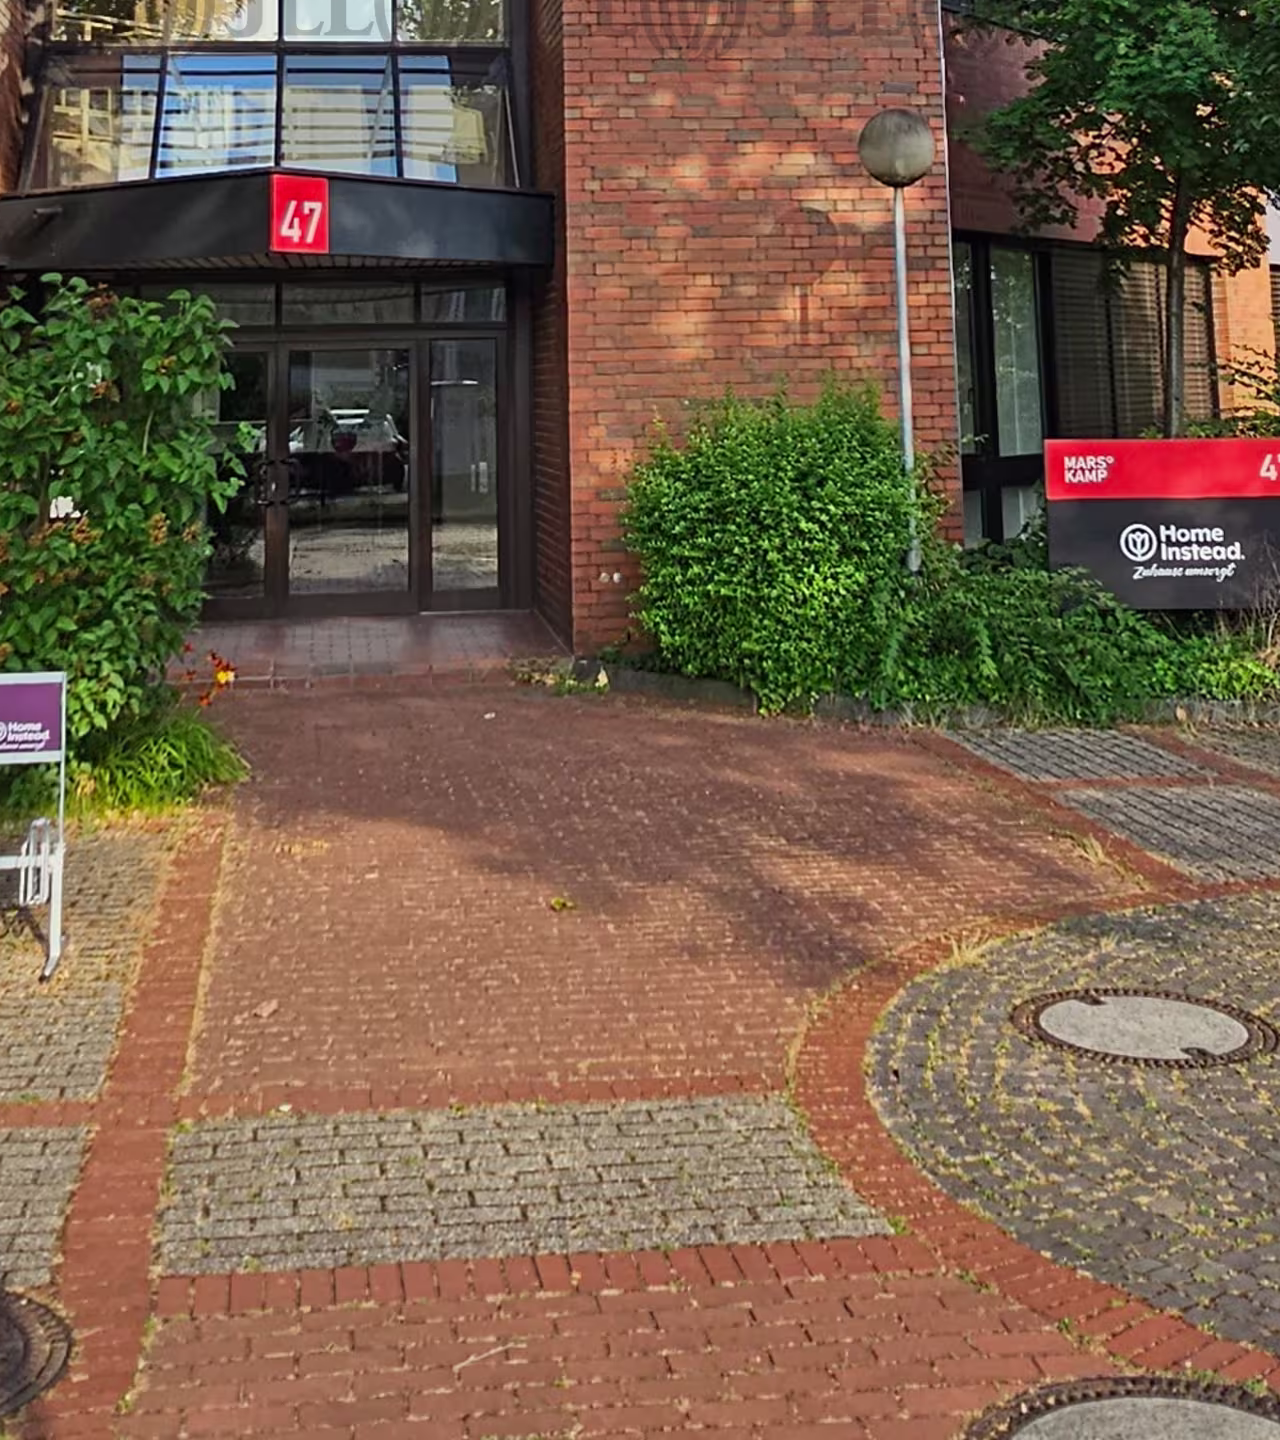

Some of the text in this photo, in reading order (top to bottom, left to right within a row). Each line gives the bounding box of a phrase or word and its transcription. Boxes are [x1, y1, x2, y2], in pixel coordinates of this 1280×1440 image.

[279, 200, 323, 244] 47
[1064, 469, 1108, 483] KAMP
[1160, 524, 1224, 542] Home
[1161, 541, 1246, 561] Instead.
[7, 721, 43, 732] Home
